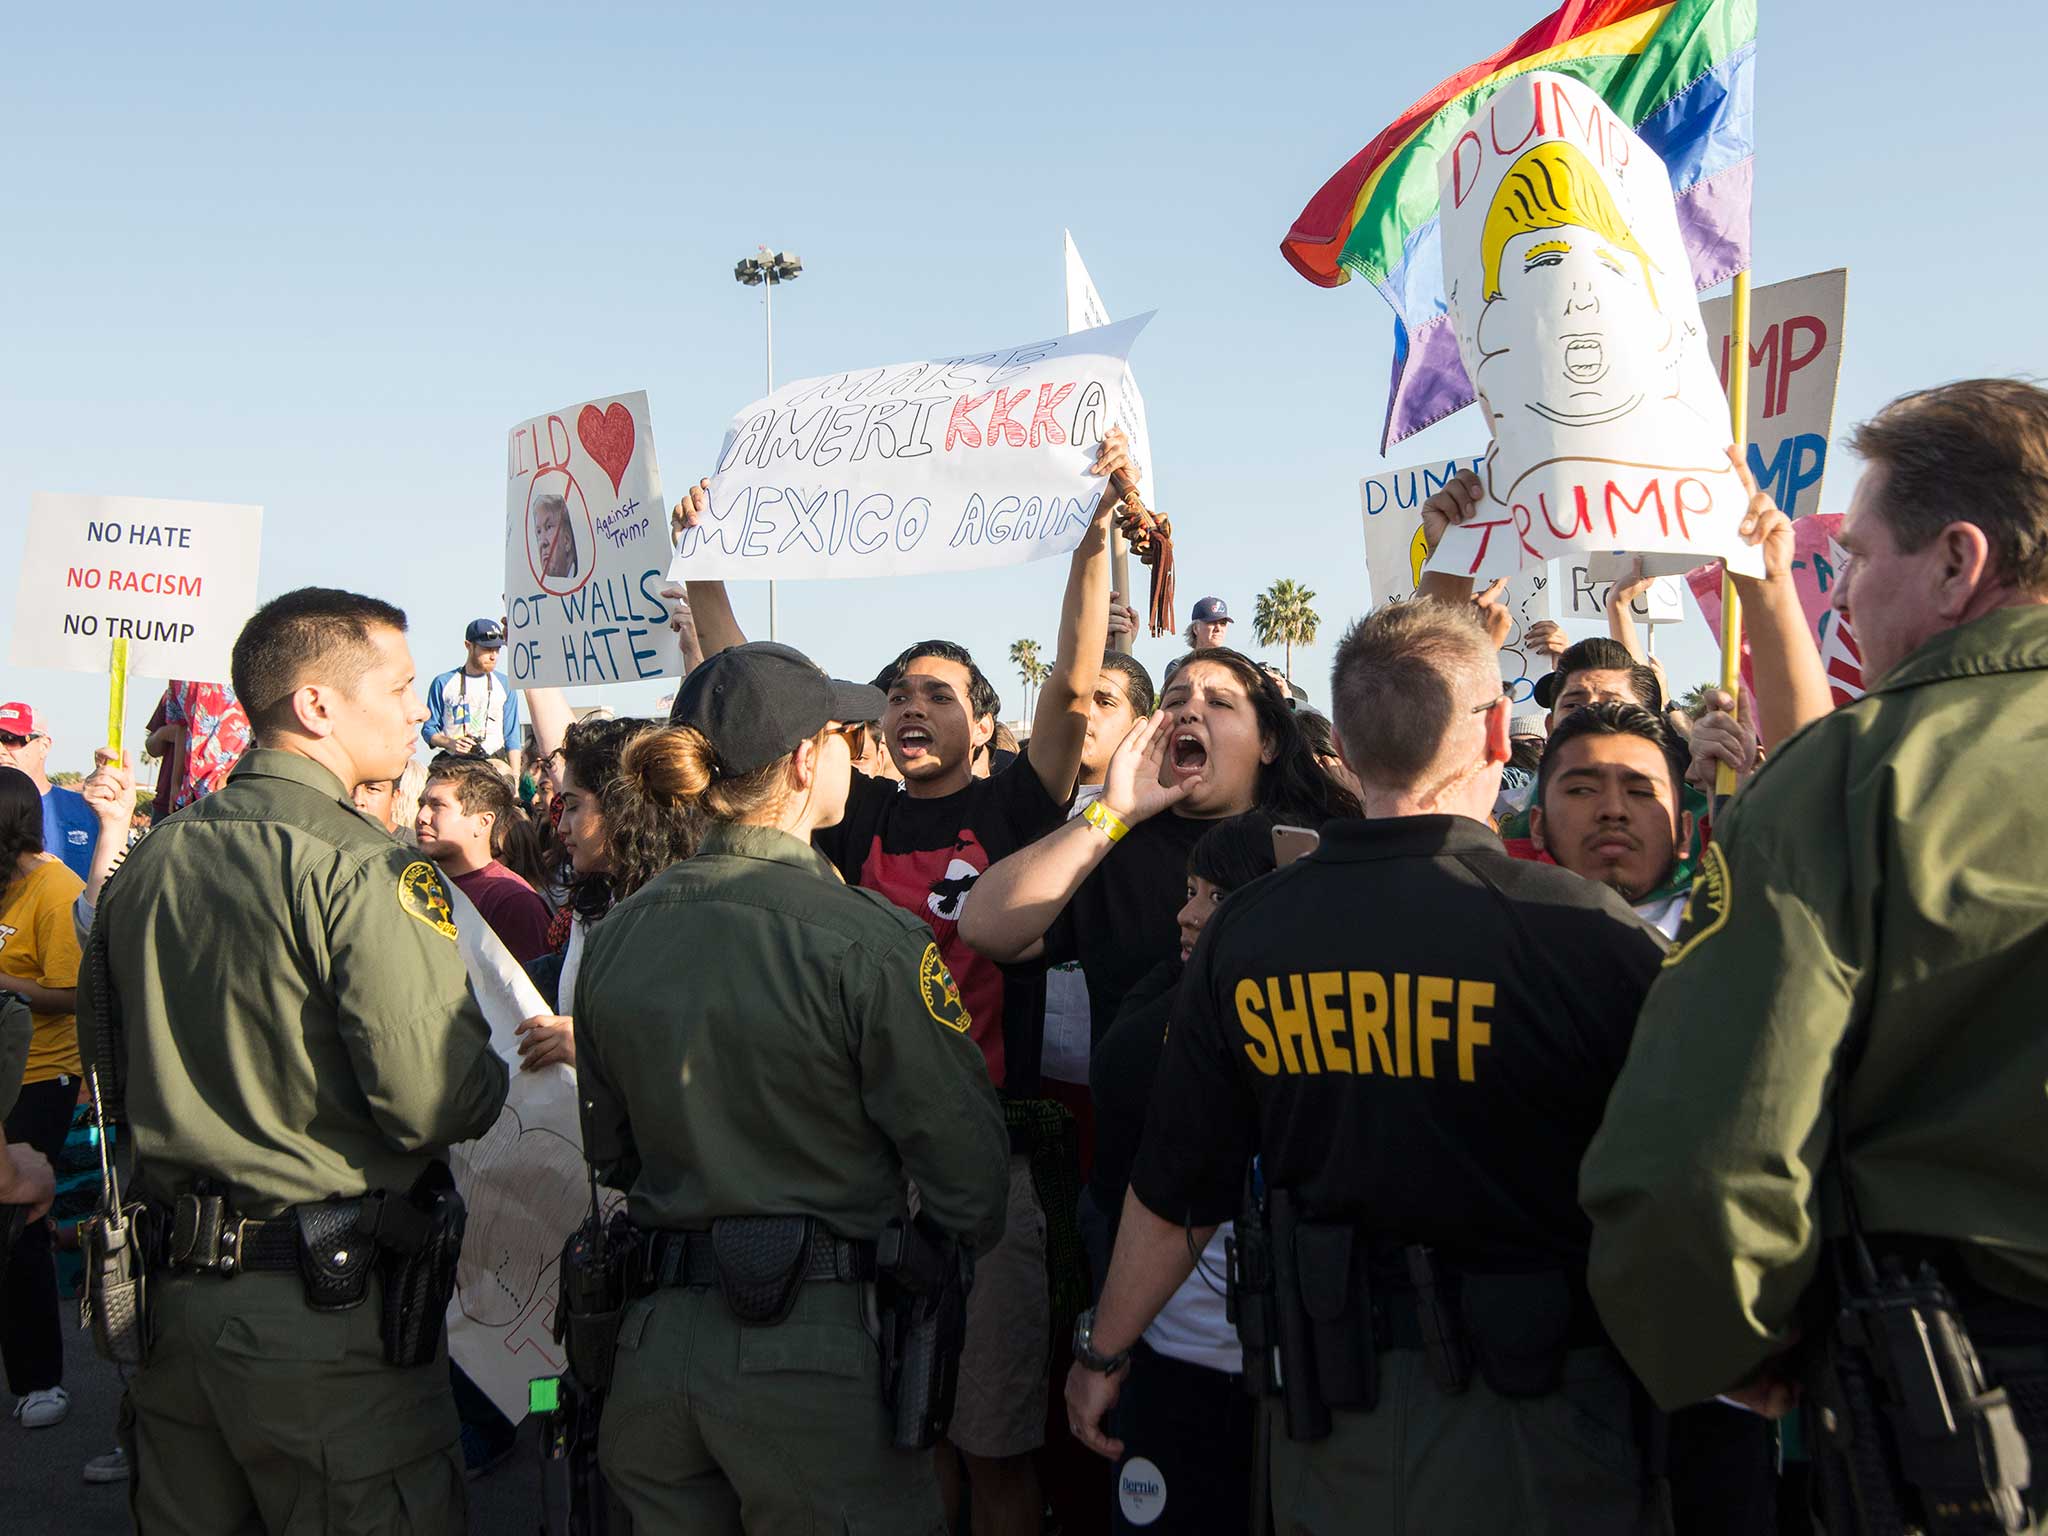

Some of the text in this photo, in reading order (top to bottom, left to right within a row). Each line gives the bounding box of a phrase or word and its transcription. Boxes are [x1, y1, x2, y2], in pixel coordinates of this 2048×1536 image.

[1452, 82, 1630, 209] DUMP
[787, 341, 1059, 407] MAKE
[717, 380, 1107, 474] AMERIKKKA
[1365, 456, 1486, 515] DUM
[87, 521, 192, 548] NO HATE
[596, 497, 640, 540] Against
[681, 485, 1104, 559] MEXICO AGAIN
[1459, 477, 1713, 575] TRUMP
[66, 567, 202, 597] NO RACISM
[559, 569, 670, 625] WALLS
[63, 614, 195, 643] NO TRUMP
[513, 627, 664, 682] OF HATE
[1235, 971, 1496, 1082] SHERIFF
